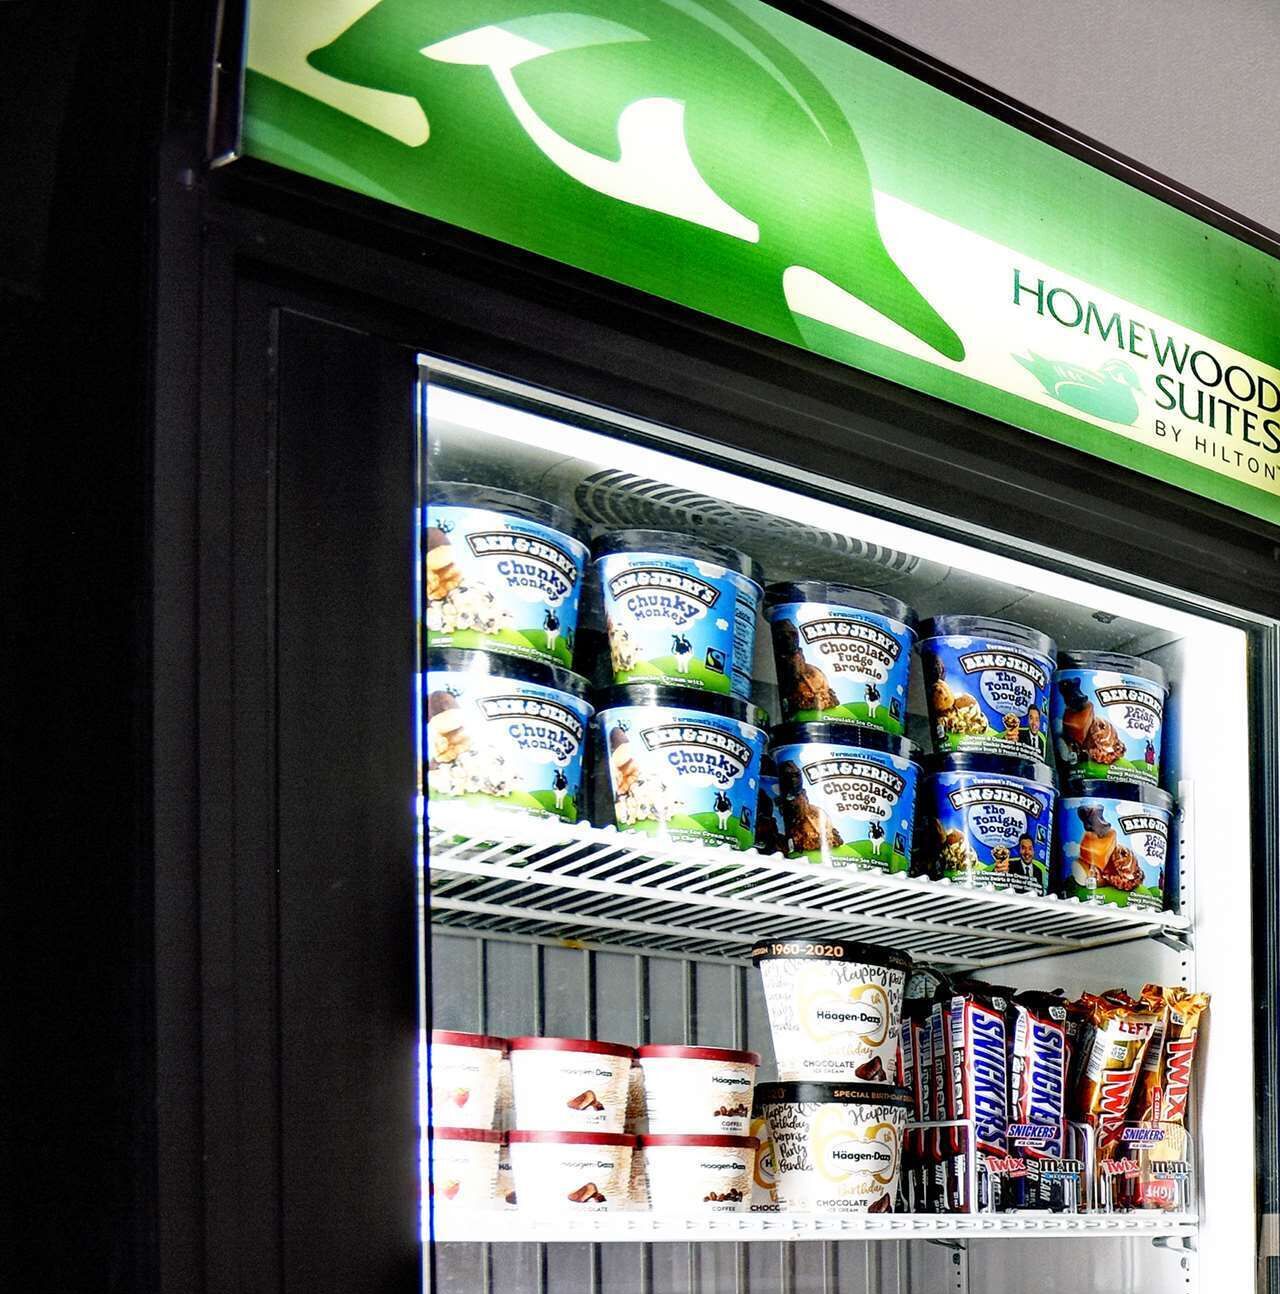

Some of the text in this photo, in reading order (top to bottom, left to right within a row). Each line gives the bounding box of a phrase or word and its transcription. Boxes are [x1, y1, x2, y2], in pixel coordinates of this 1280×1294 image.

[1155, 420, 1276, 481] BY HILTON
[497, 558, 568, 596] Chunky
[507, 576, 559, 601] Monkey
[627, 595, 700, 618] Chunky
[634, 608, 688, 626] Monkey
[820, 642, 891, 667] Chocolate
[838, 653, 873, 667] Fudge
[833, 663, 883, 681] Brownie
[995, 671, 1017, 683] The
[985, 681, 1032, 699] Tonight
[991, 691, 1028, 707] Dough
[508, 723, 575, 756] Chunky
[517, 738, 567, 761] Monkey
[667, 750, 740, 778] Chunky
[676, 764, 729, 785] Monkey
[823, 781, 894, 802] Chocolate
[841, 791, 877, 805] Fudge
[836, 802, 886, 817] Brownie
[983, 805, 1005, 815] The
[973, 814, 1023, 830] Tonight
[979, 824, 1019, 839] Dough
[771, 943, 844, 958] 1960-2020
[832, 965, 890, 987] Happy
[816, 1010, 881, 1025] Häagen-Dazs
[1118, 1021, 1154, 1038] LEFT
[803, 1059, 855, 1069] CHOCOLATE
[971, 1011, 1008, 1150] SNICKERS
[1165, 1038, 1195, 1119] TWIX
[833, 1089, 870, 1100] SPECIAL
[849, 1105, 898, 1125] Happy
[1099, 1070, 1137, 1147] TWIX
[1007, 1125, 1056, 1138] SNICKERS
[1123, 1128, 1166, 1141] SNICKERS
[832, 1149, 891, 1162] Häagen-Dazs
[985, 1156, 1026, 1173] Twix
[1102, 1158, 1139, 1174] Twix
[816, 1199, 868, 1207] CHOCOLATE
